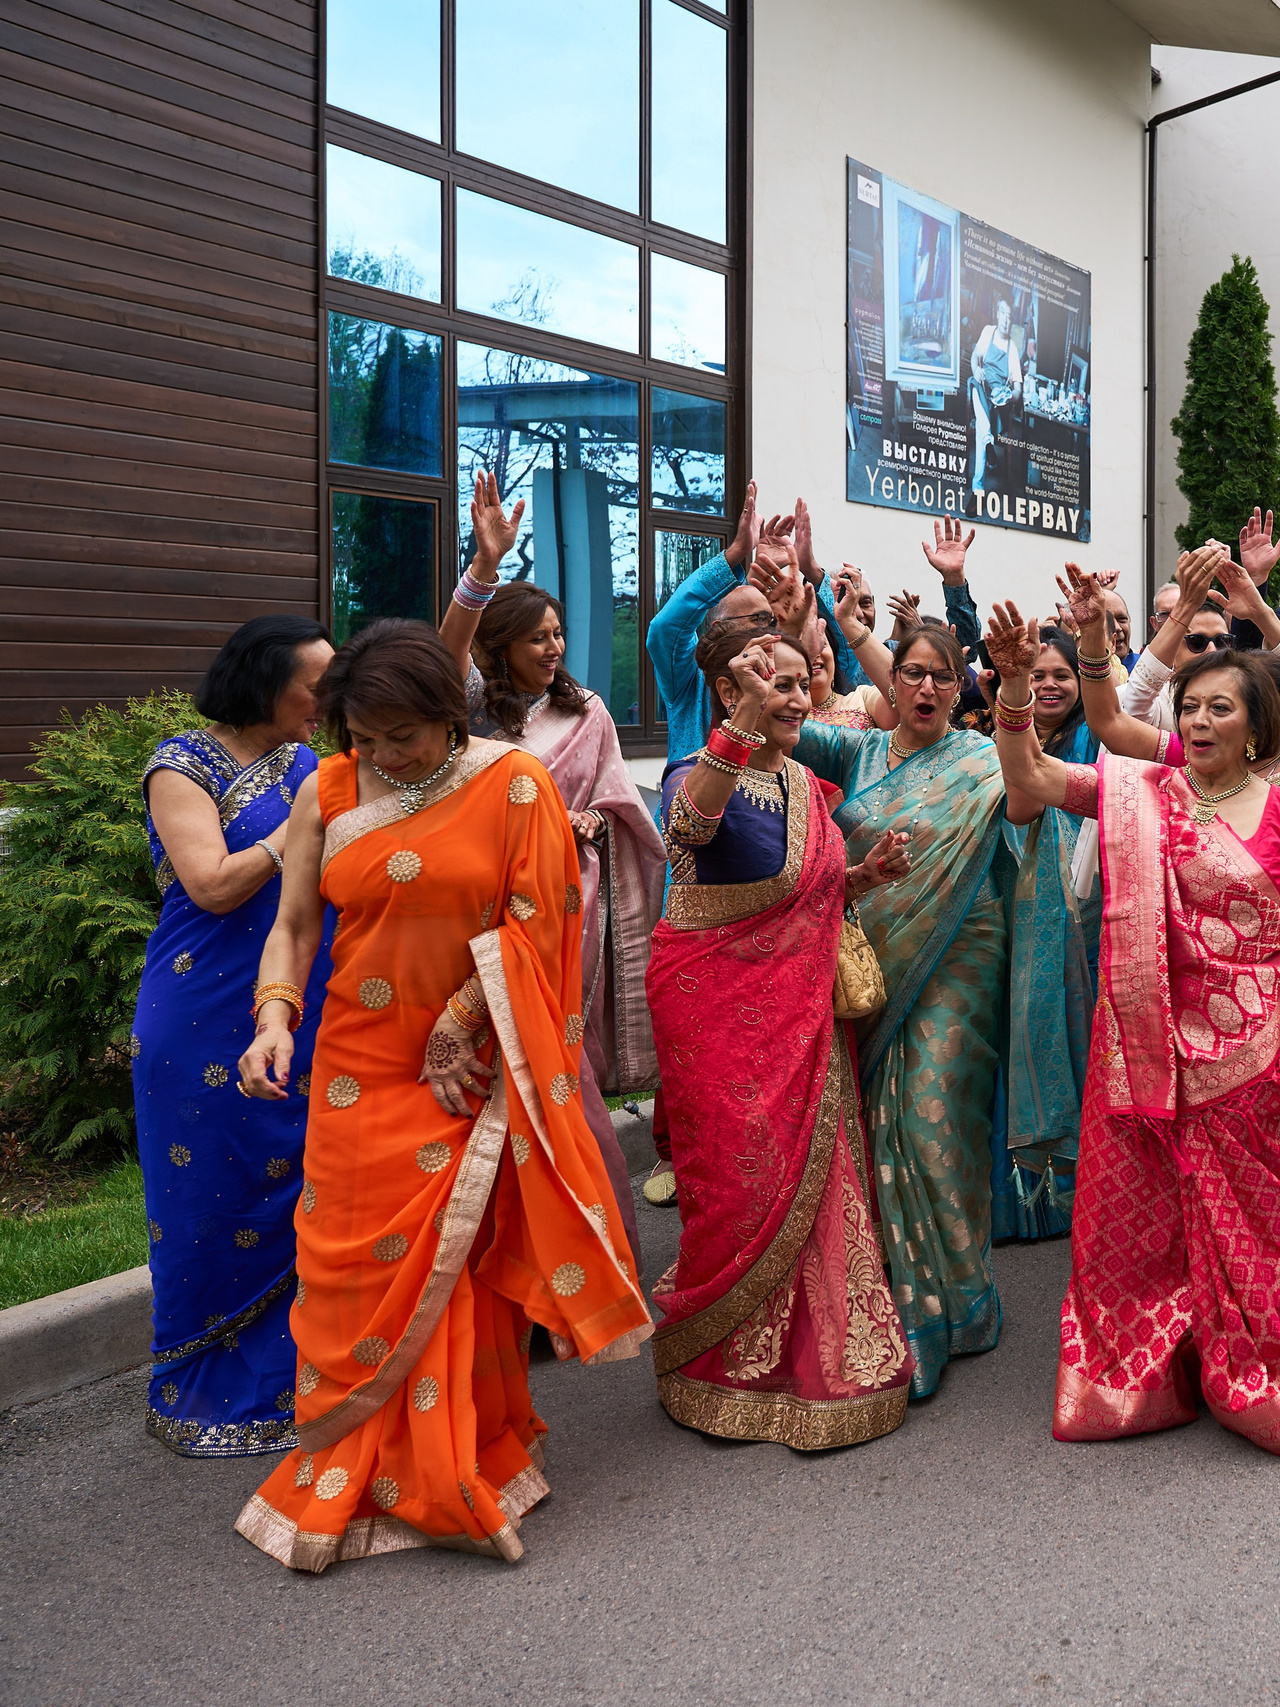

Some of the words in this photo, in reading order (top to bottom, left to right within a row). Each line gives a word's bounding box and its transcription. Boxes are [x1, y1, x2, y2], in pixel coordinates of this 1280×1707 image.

[989, 239, 996, 248] no
[996, 242, 1016, 257] genuine
[1017, 250, 1025, 261] life
[1026, 256, 1043, 269] without
[913, 411, 936, 425] Вашему
[937, 419, 966, 433] вниманию!
[913, 421, 937, 435] Галерея
[939, 428, 967, 442] Pygmalion
[929, 436, 966, 452] представляет
[998, 434, 1018, 447] Personal
[1026, 443, 1049, 455] collection
[1064, 454, 1080, 462] symbol
[883, 439, 967, 474] ВЫСТАВКУ
[1036, 455, 1053, 465] spiritual
[1054, 460, 1079, 471] perception!
[878, 459, 908, 472] всемирно
[909, 465, 942, 479] известного
[942, 473, 967, 484] мастера
[1040, 465, 1054, 473] would
[1063, 469, 1068, 477] to
[1068, 470, 1079, 480] bring
[1025, 486, 1033, 495] the
[1034, 490, 1064, 501] world-famous
[1054, 483, 1073, 495] Paintings
[1074, 488, 1079, 497] by
[1058, 478, 1079, 488] attention!
[865, 465, 965, 513] Yerbolat
[975, 488, 1080, 534] TOLEPBAY
